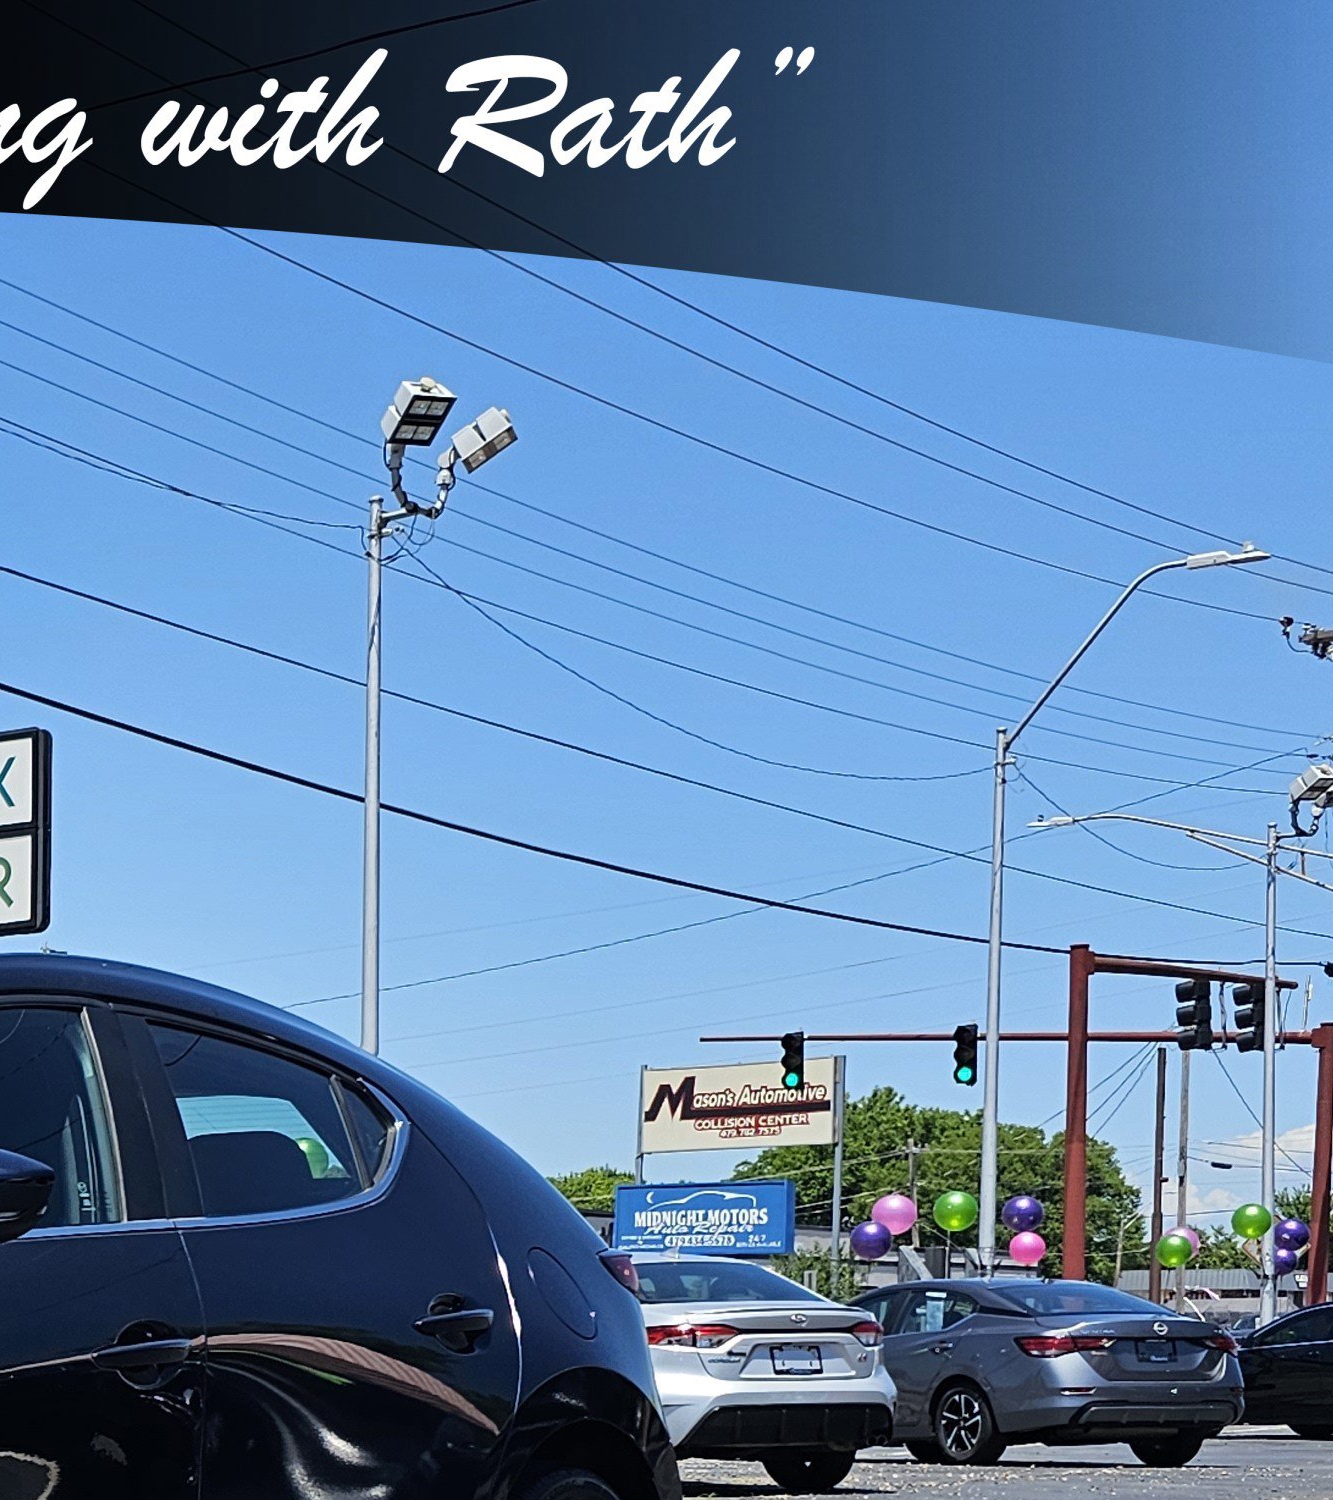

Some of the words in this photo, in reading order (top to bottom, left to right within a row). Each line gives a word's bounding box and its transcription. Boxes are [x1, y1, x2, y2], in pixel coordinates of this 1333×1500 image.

[644, 1076, 735, 1122] Mason's
[694, 1116, 755, 1130] COLLISION
[760, 1113, 807, 1127] CENTER
[635, 1209, 706, 1228] MIDNIGHT
[708, 1208, 768, 1225] MOTORS
[643, 1223, 689, 1235] Auto
[692, 1222, 754, 1239] Repair
